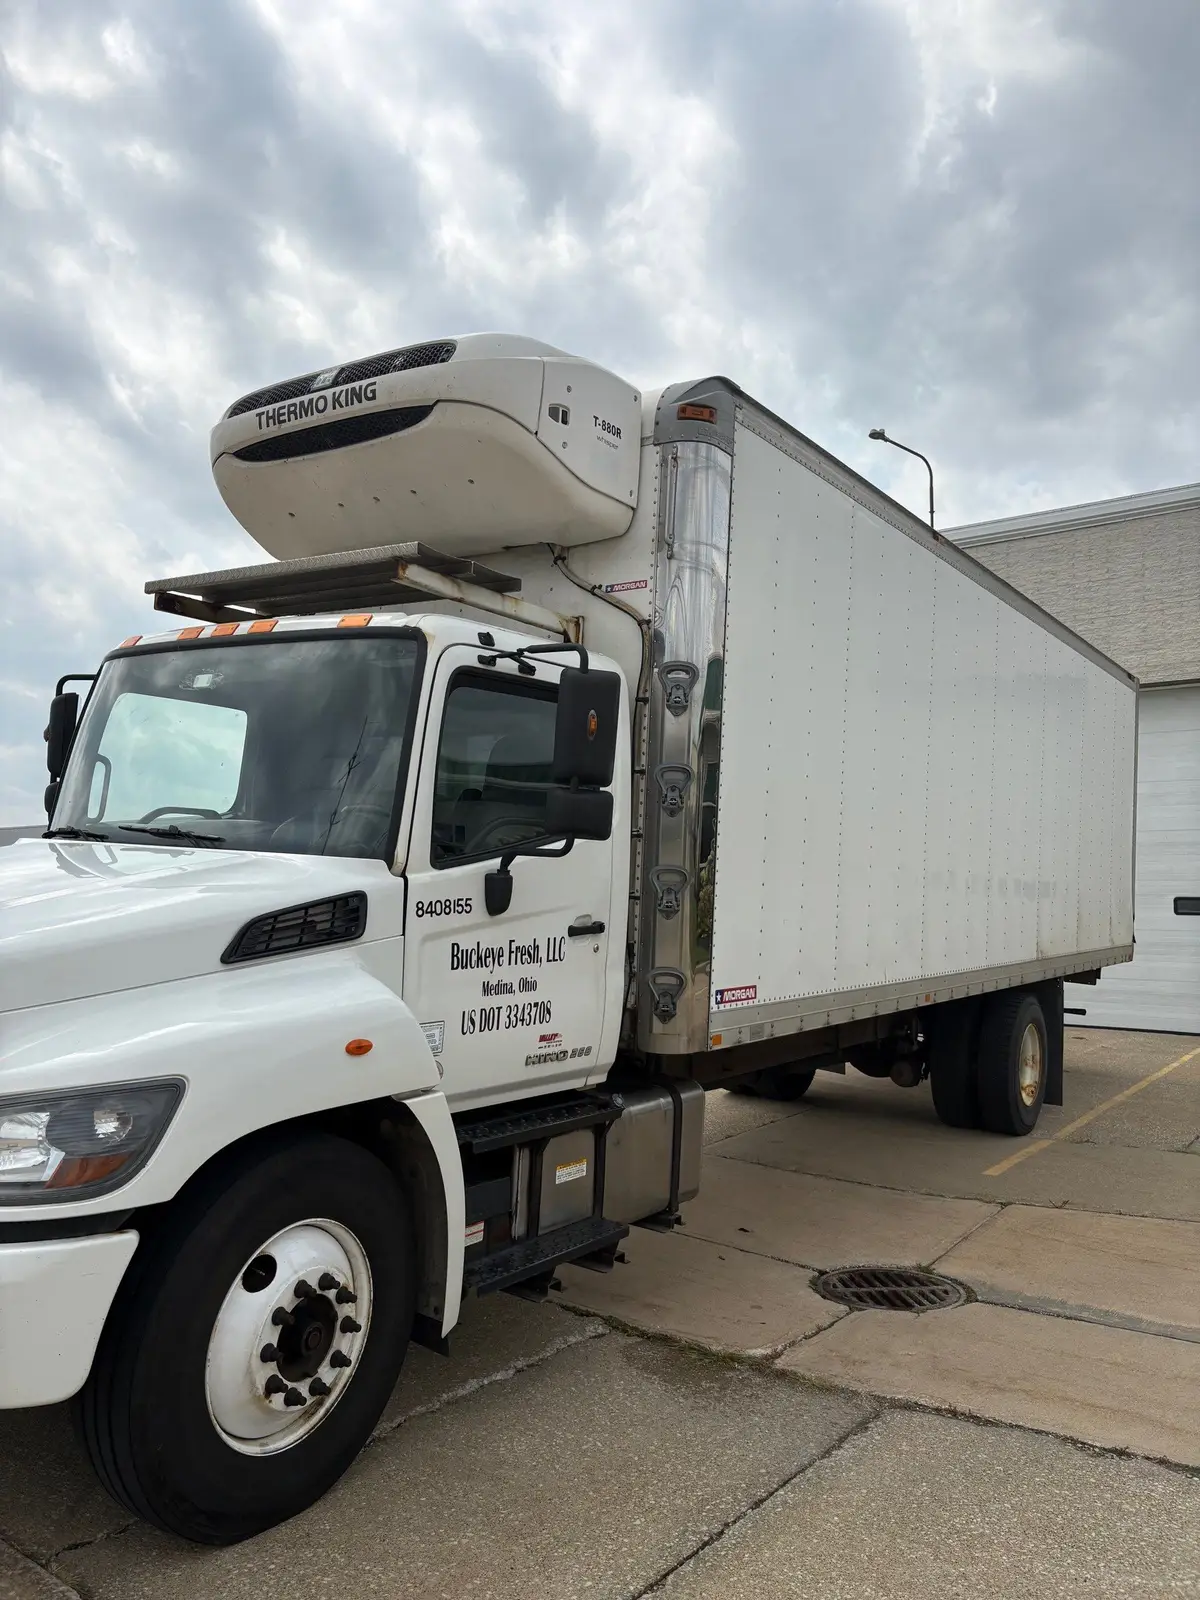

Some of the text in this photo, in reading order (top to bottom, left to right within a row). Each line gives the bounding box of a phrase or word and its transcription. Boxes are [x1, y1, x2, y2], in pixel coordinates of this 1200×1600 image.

[255, 381, 377, 430] THERMO KING
[593, 415, 622, 440] T-880R
[612, 580, 647, 592] MORGAN
[415, 897, 473, 918] 8408155
[450, 936, 566, 974] Buckeye Fresh, LLC
[481, 976, 538, 997] Medina, Ohio
[722, 987, 756, 1002] MORGAN
[461, 1000, 552, 1036] US DOT 3343708
[525, 1049, 569, 1067] HINO
